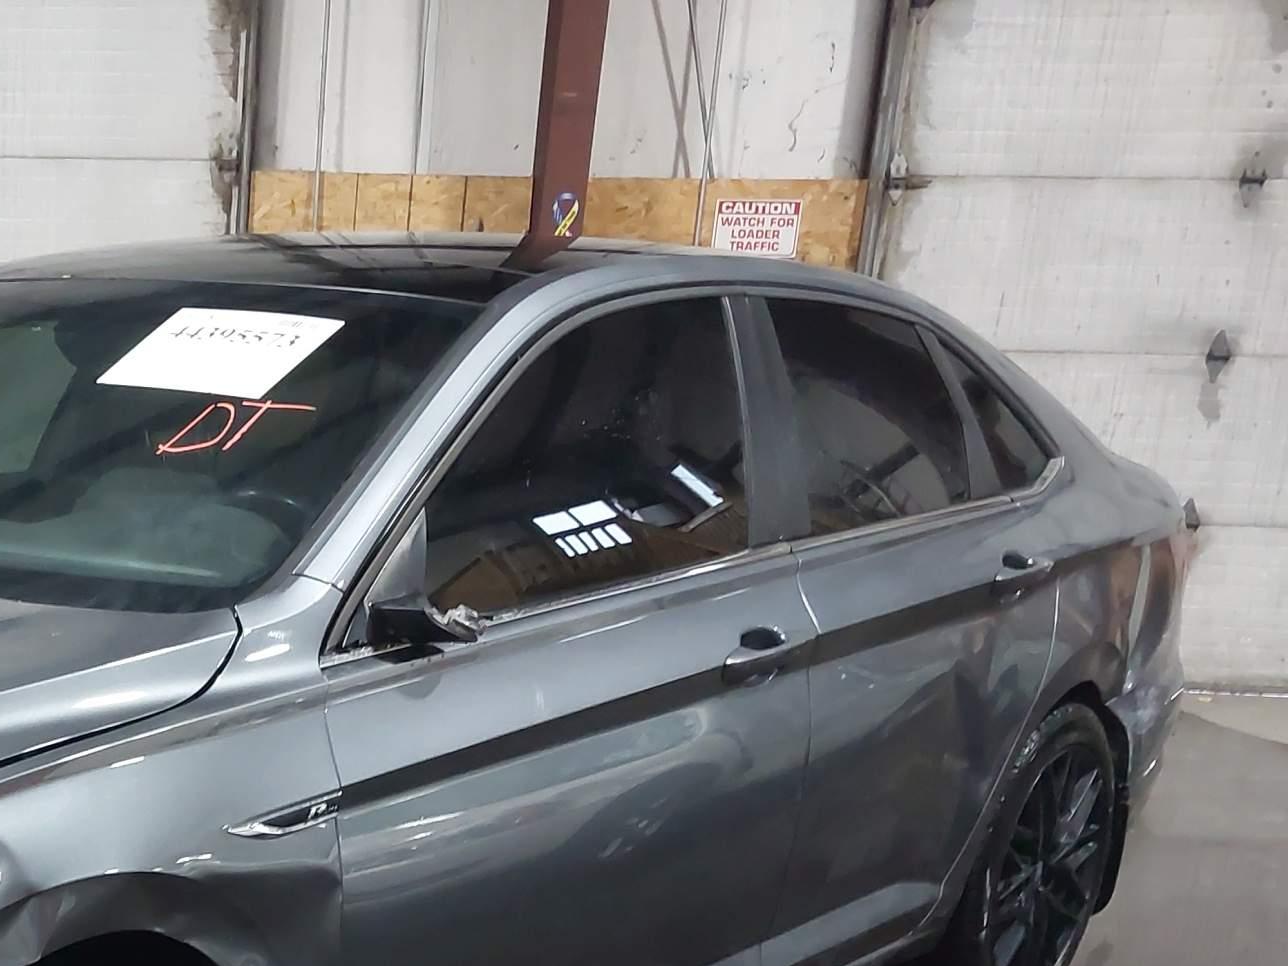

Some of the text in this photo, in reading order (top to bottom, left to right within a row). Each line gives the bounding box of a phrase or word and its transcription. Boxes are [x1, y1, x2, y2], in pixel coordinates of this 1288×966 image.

[721, 201, 795, 214] CAUTION
[721, 216, 795, 228] WATCH FOR
[731, 229, 780, 239] LOADER
[730, 240, 779, 252] TRAFFIC
